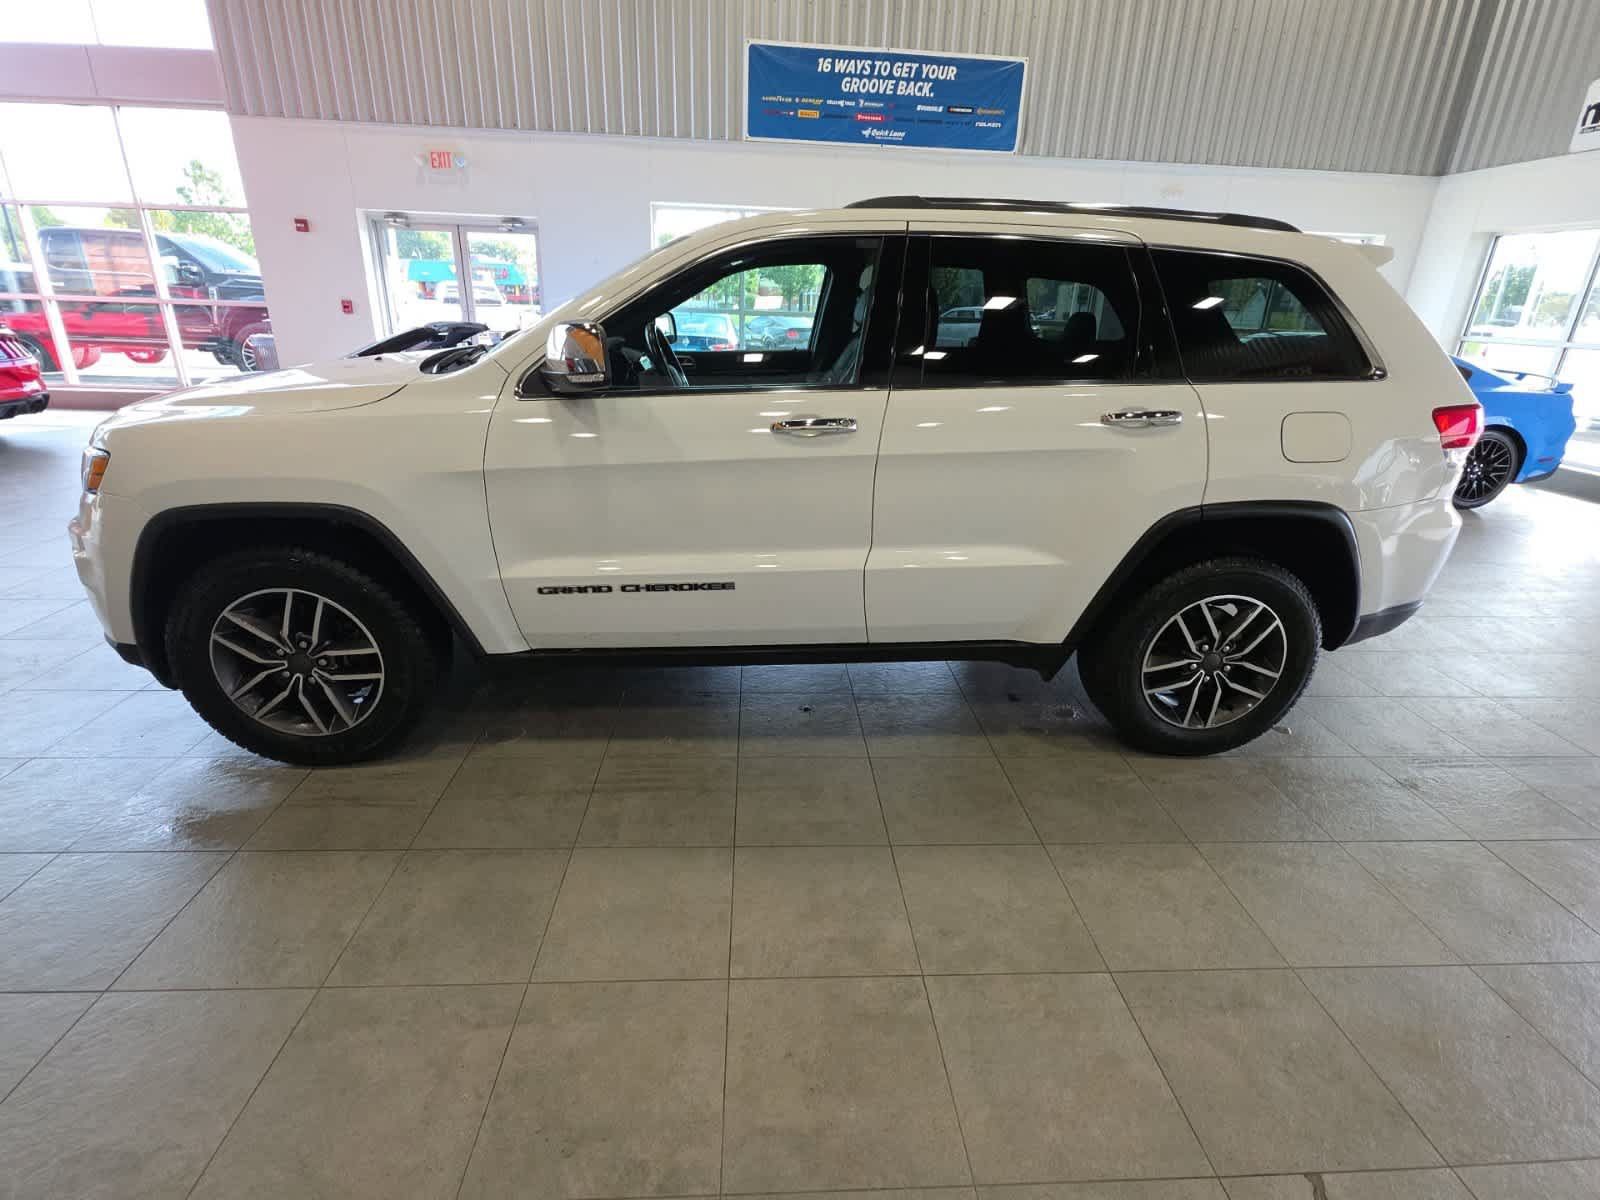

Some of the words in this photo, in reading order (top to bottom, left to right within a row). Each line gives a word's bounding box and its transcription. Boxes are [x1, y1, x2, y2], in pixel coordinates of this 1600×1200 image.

[817, 57, 833, 73] 16
[834, 58, 872, 75] WAYS
[874, 60, 891, 76] TO
[892, 62, 919, 78] GET
[922, 63, 957, 80] YOUR
[841, 77, 896, 94] GROOVE
[897, 81, 934, 97] BACK.
[430, 151, 451, 168] EXIT
[537, 585, 613, 595] GRAND
[620, 582, 735, 593] CHEROKEE
